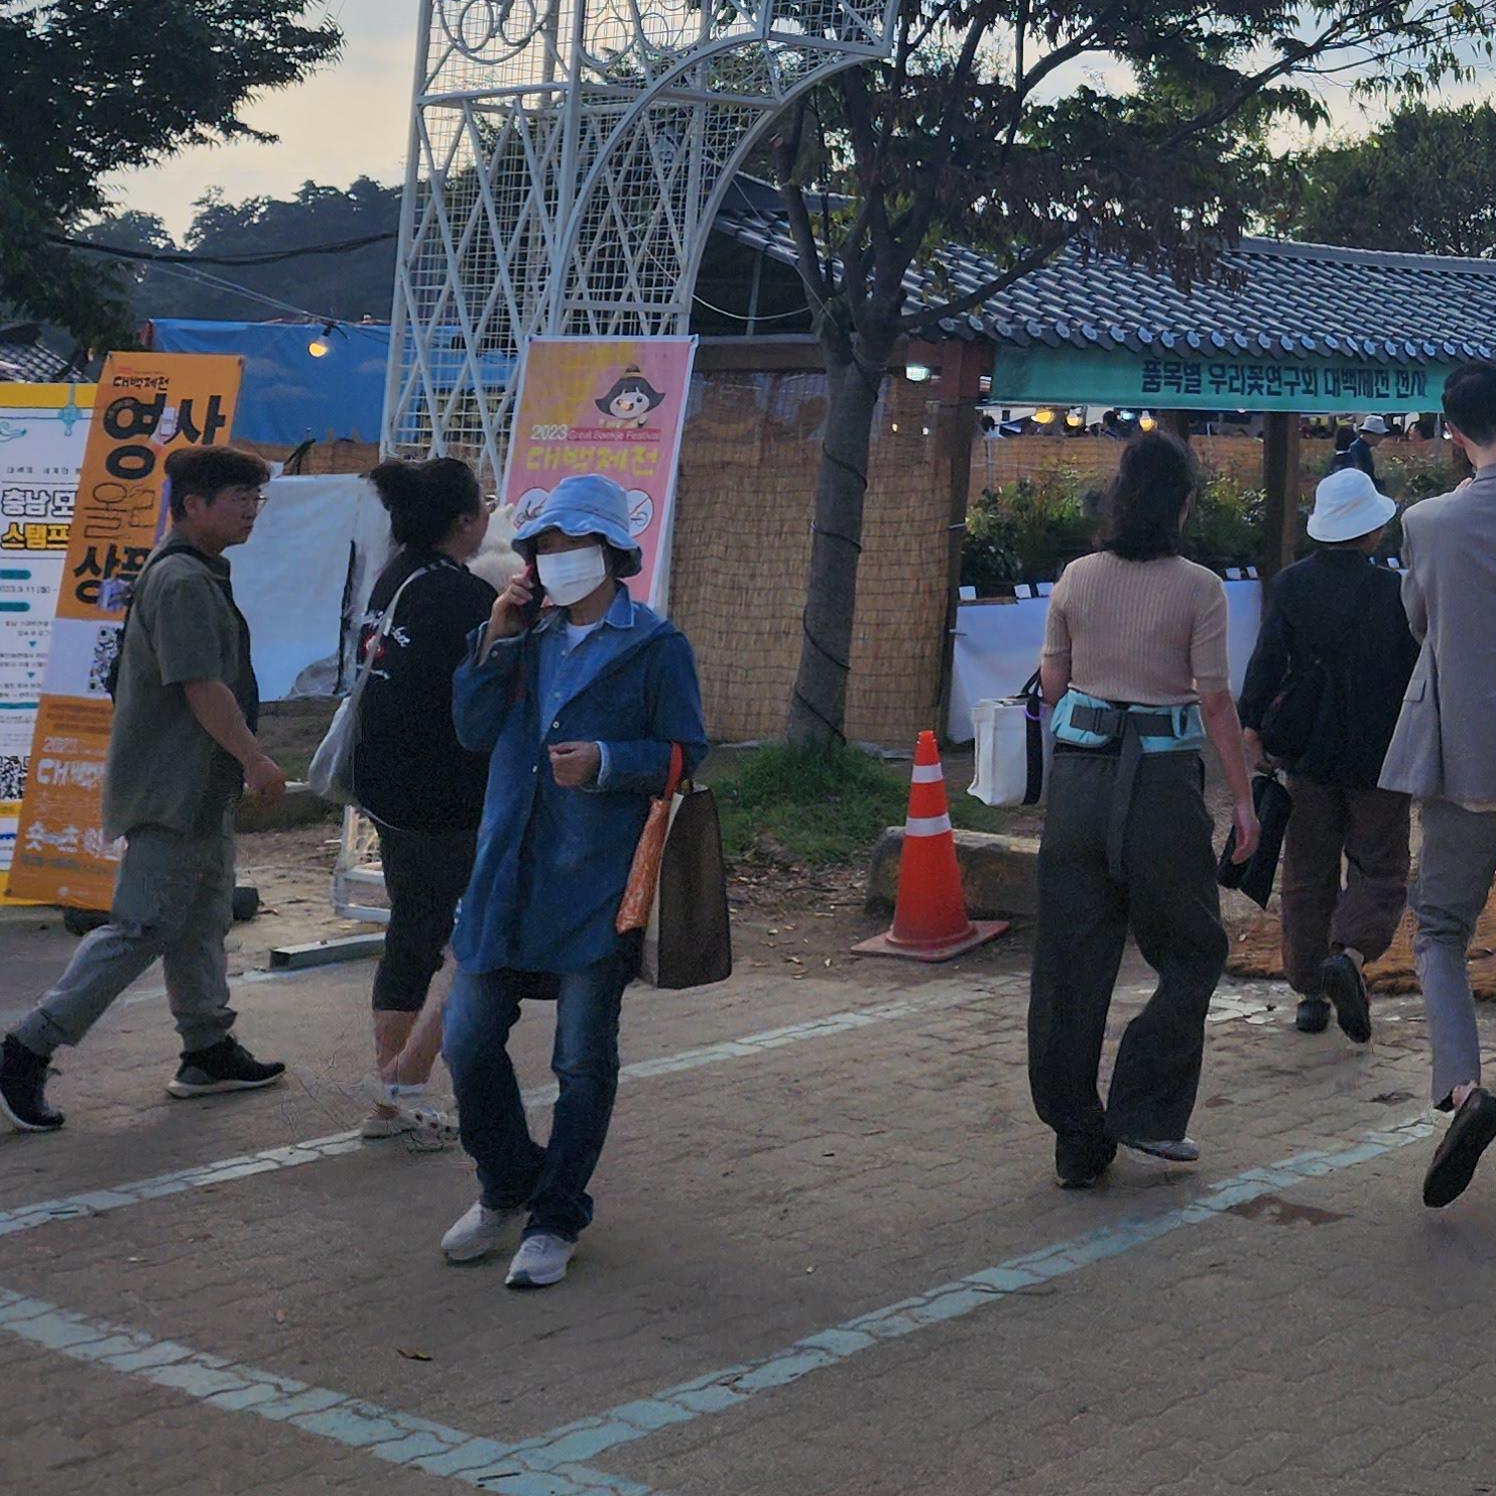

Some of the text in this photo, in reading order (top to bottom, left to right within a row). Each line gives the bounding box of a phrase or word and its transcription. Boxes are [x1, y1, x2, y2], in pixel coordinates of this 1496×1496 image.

[1142, 359, 1200, 395] 품목별
[1207, 363, 1318, 397] 우리꽃연구회
[1324, 366, 1391, 399] 대백제전
[530, 424, 568, 441] 2023
[526, 446, 659, 477] 대백제전
